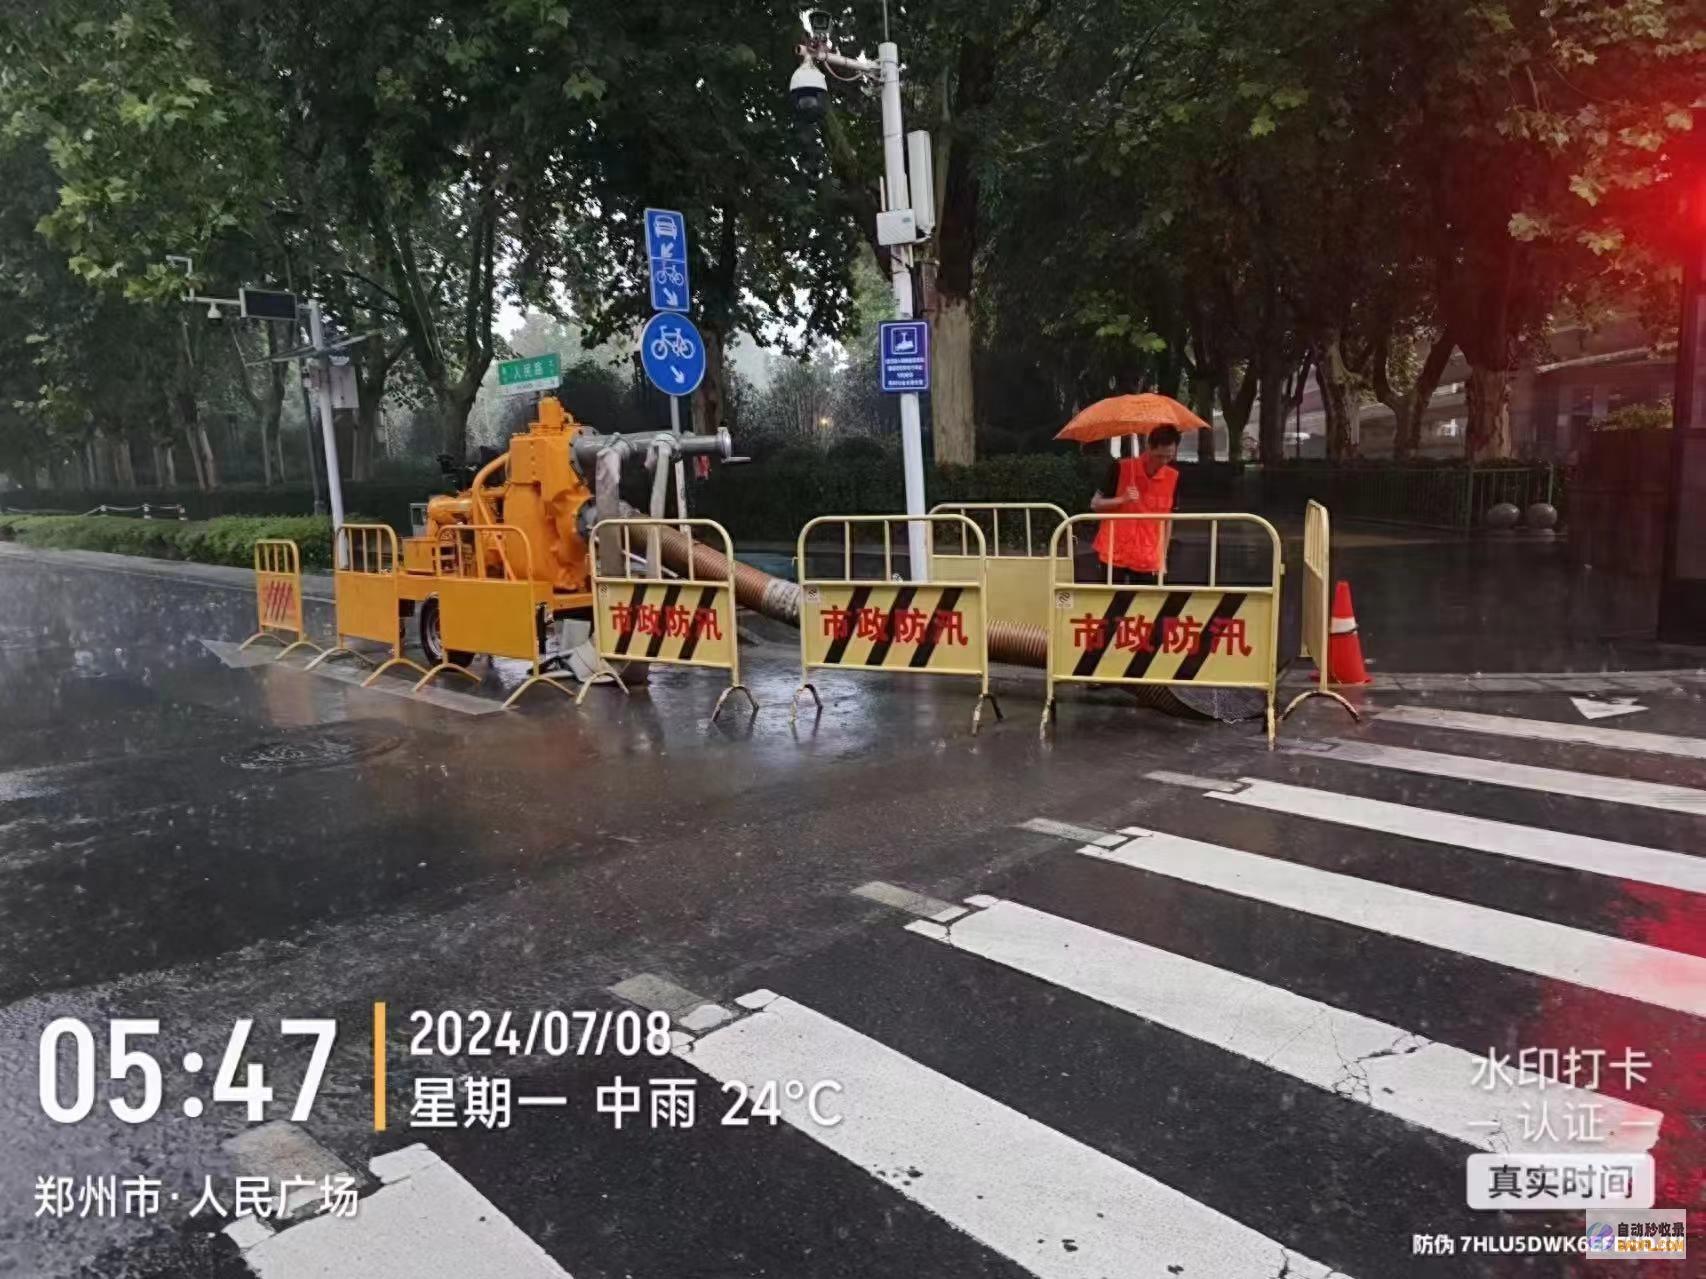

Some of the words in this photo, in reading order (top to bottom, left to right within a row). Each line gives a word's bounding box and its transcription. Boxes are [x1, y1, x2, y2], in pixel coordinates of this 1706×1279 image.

[609, 601, 723, 641] 市政防汛
[820, 605, 968, 646] 市政防汛
[1070, 612, 1252, 656] 市政防汛
